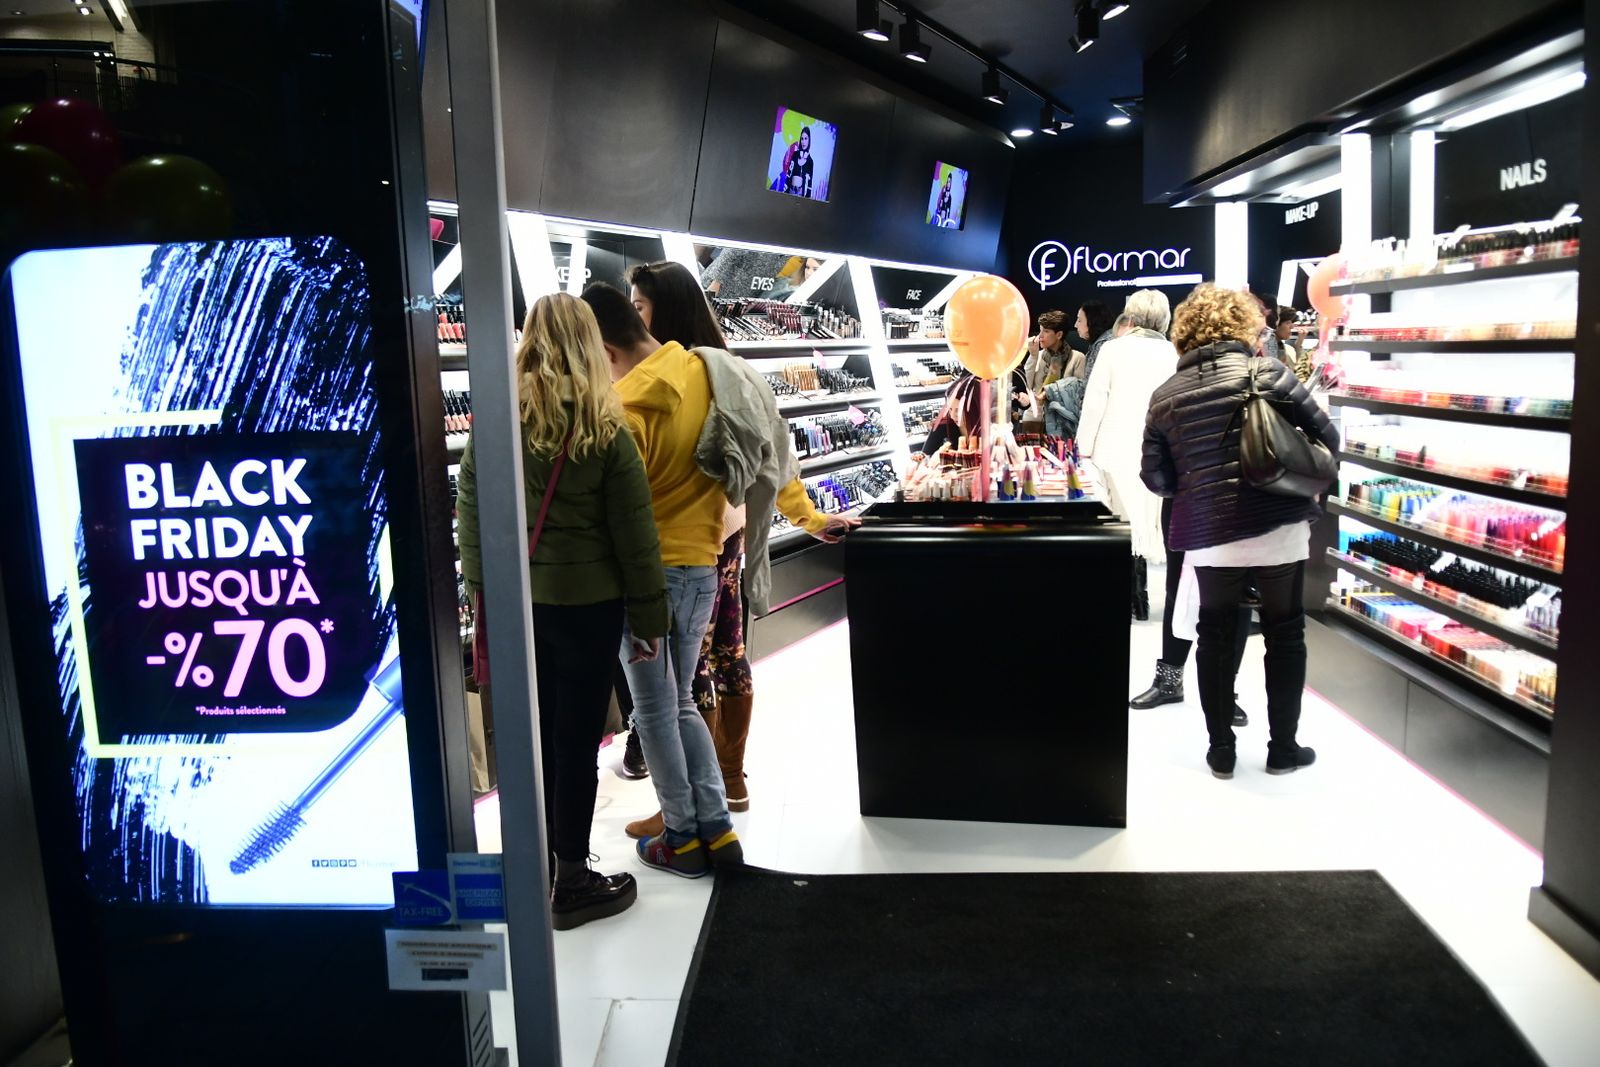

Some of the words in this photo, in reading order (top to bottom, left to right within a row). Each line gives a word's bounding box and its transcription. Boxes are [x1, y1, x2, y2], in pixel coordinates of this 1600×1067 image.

[1500, 158, 1547, 191] NAILS
[1285, 201, 1319, 225] MAKE-UP
[1073, 246, 1191, 274] flormar
[750, 276, 775, 291] EYES
[905, 289, 922, 301] FACE
[124, 458, 312, 510] BLACK
[130, 514, 313, 561] FRIDAY
[138, 557, 321, 616] JUSQU'À
[235, 705, 287, 716] sélectionnés
